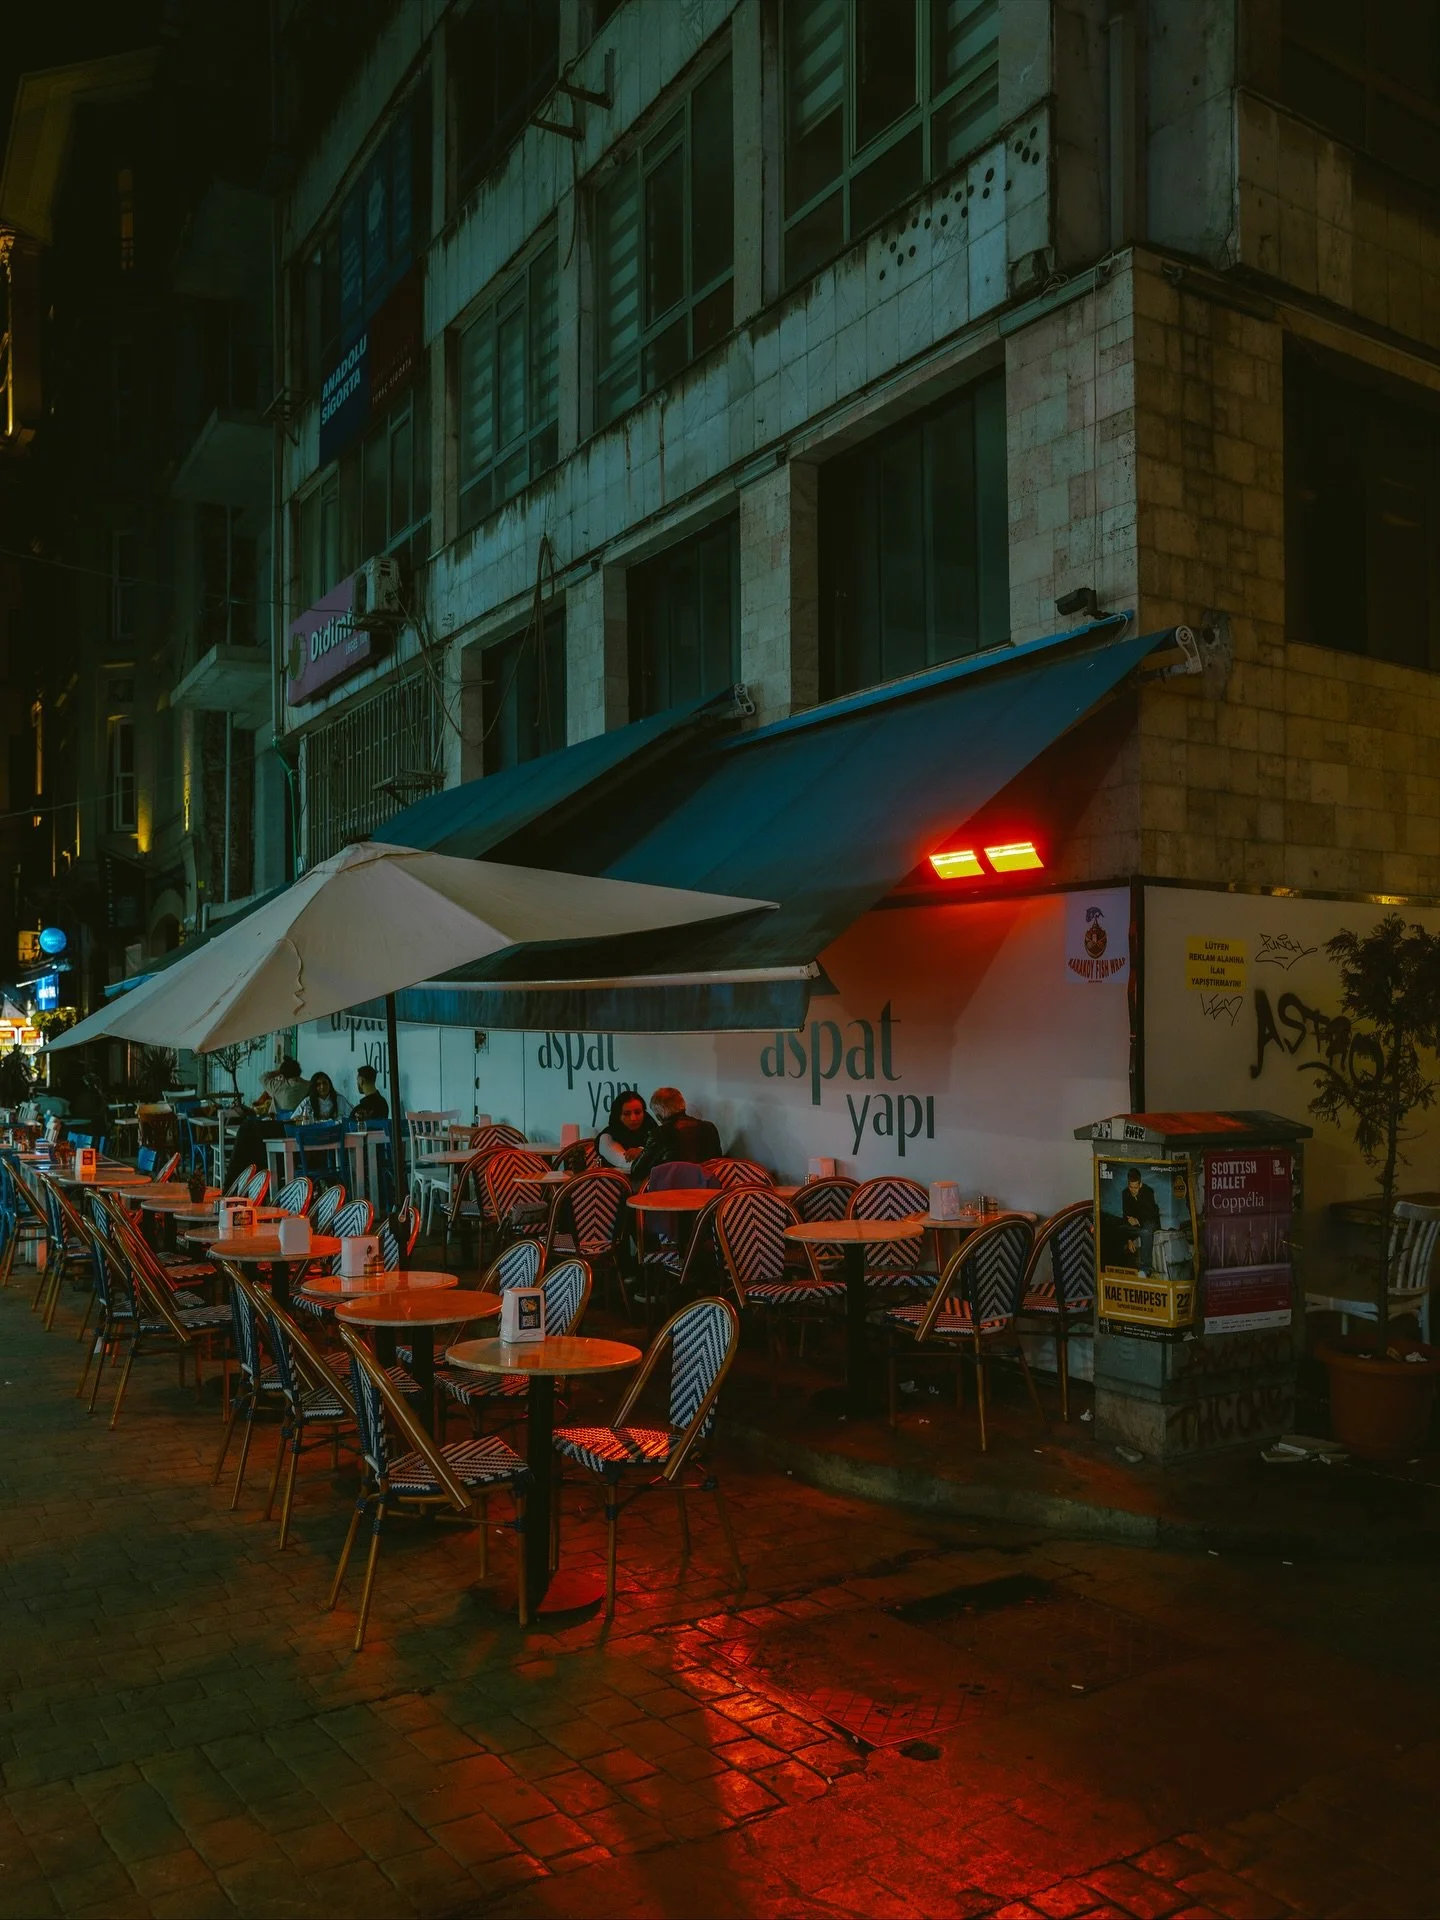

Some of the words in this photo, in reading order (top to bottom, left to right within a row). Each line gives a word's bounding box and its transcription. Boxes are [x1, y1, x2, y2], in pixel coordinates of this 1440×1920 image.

[322, 332, 367, 402] ANADOLU
[321, 366, 361, 426] SİGORTA
[1204, 940, 1229, 951] LÜTFEN
[1189, 952, 1216, 962] REKLAM
[1217, 954, 1245, 965] ALANINA
[760, 999, 903, 1106] aspat
[846, 1093, 935, 1157] yapı
[1211, 1160, 1257, 1175] SCOTTISH
[1211, 1175, 1246, 1190] BALLET
[1211, 1191, 1265, 1214] Coppélia
[1104, 1285, 1122, 1302] KAE
[1122, 1288, 1168, 1308] TEMPEST
